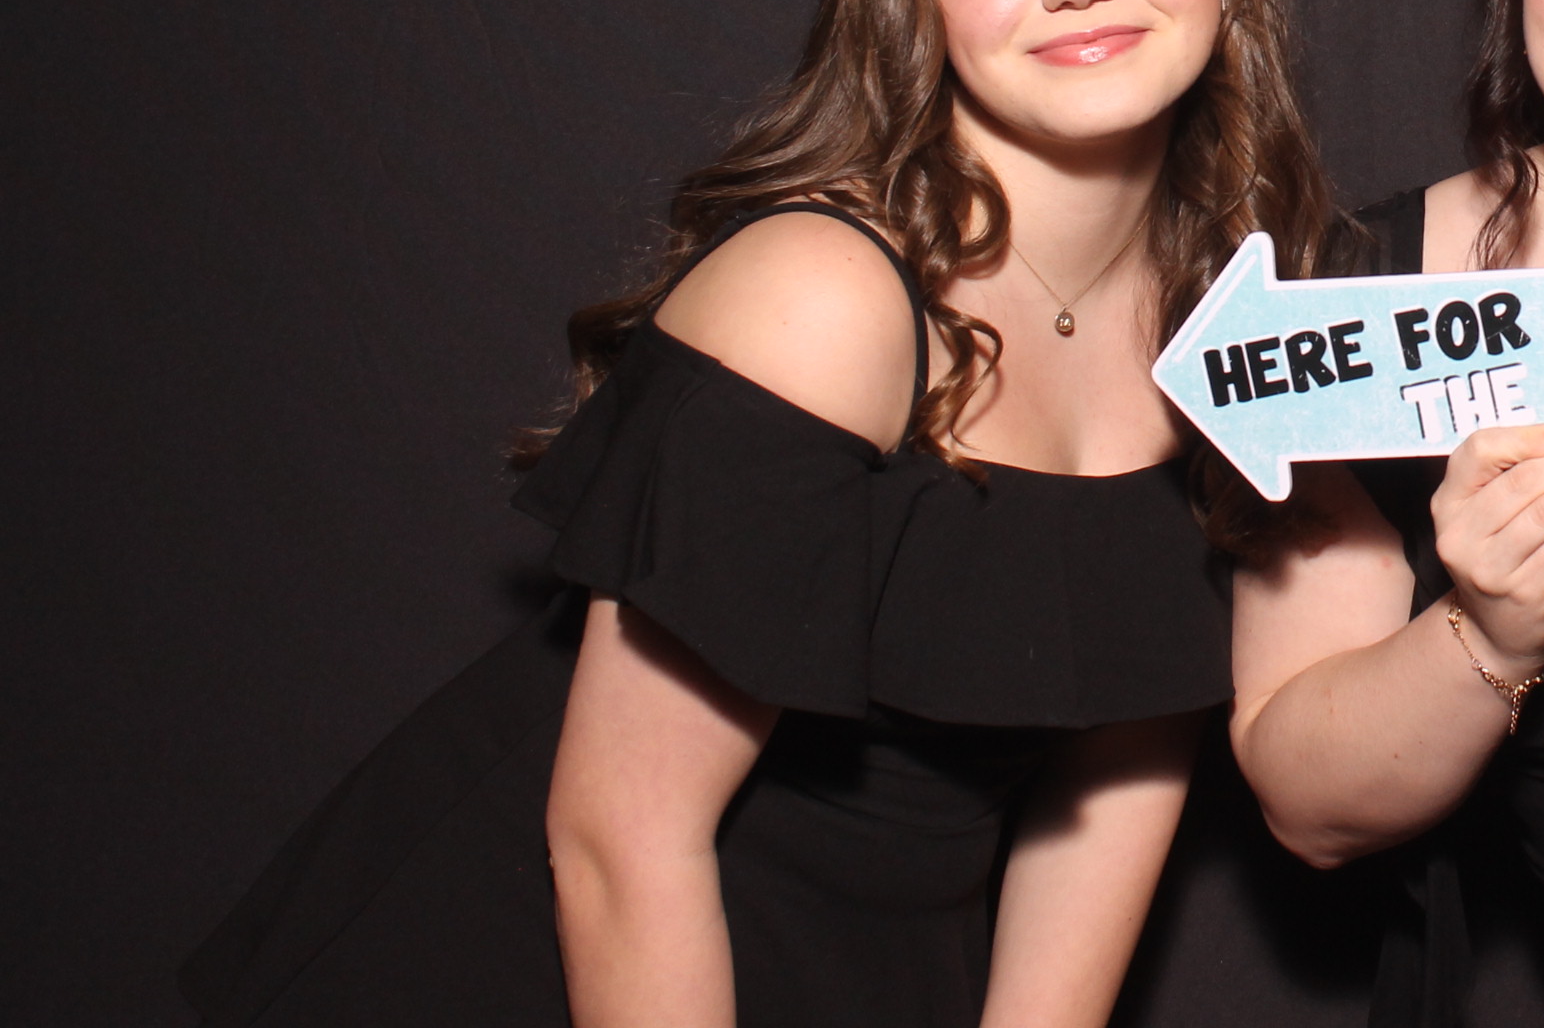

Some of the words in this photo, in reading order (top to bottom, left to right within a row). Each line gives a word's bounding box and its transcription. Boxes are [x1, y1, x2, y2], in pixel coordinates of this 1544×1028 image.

[1203, 320, 1373, 407] HERE
[1394, 292, 1531, 370] FOR
[1400, 363, 1536, 442] THE
